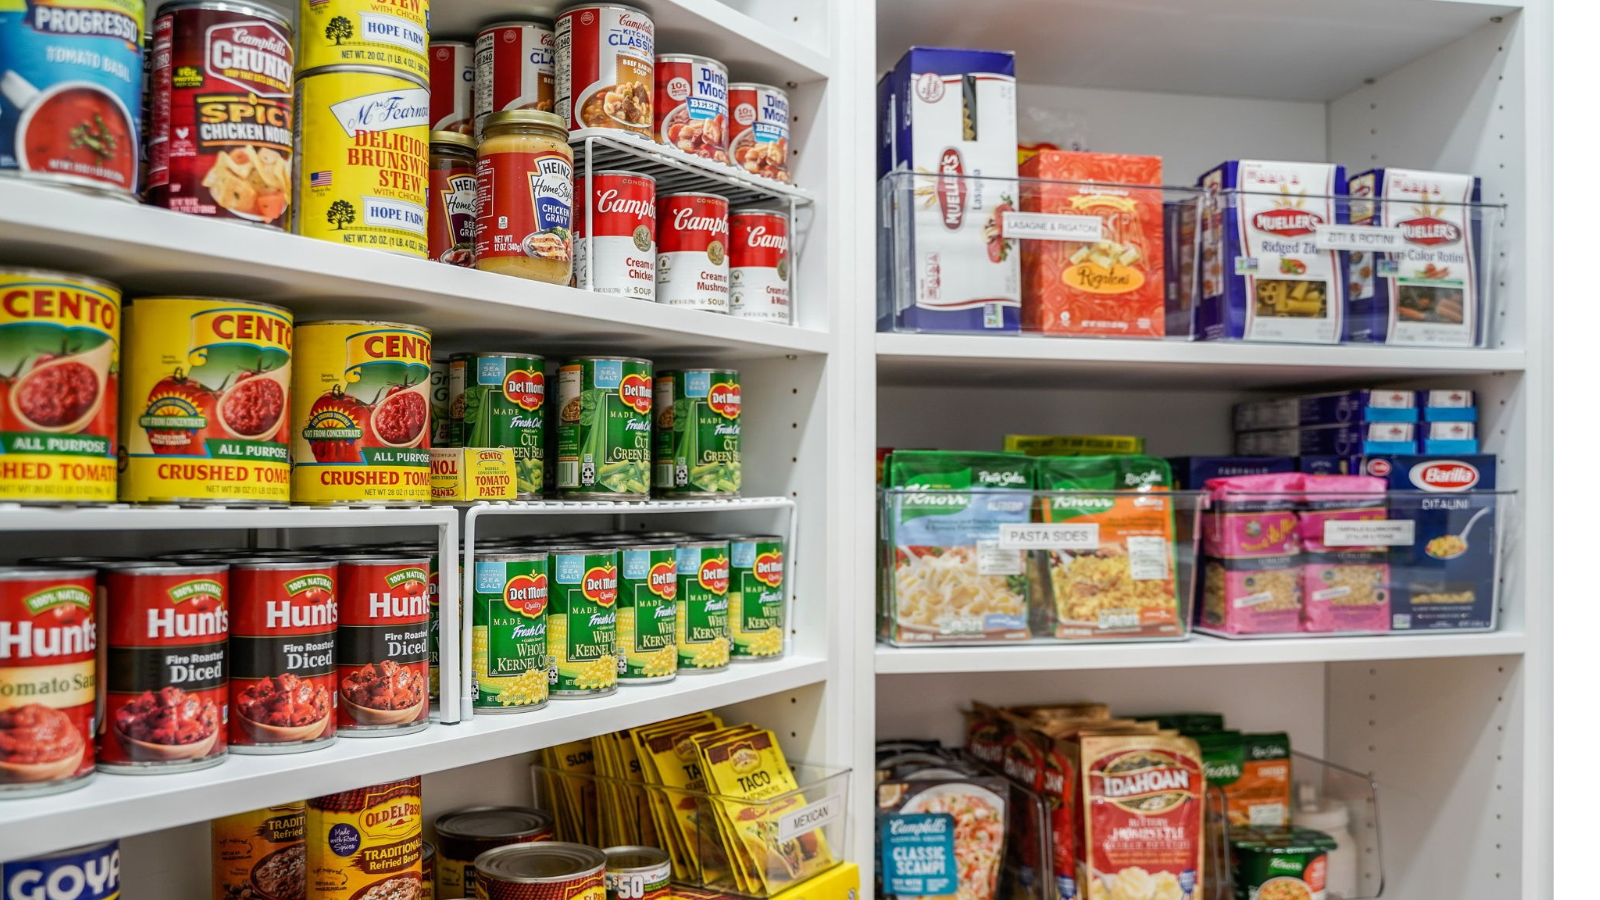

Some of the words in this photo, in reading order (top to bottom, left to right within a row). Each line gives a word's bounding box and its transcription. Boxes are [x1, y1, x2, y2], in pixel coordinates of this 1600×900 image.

[371, 4, 393, 14] WITH
[396, 8, 423, 24] CHICKEN
[35, 6, 137, 43] PROGRESSO
[368, 22, 400, 37] HOPE
[403, 29, 424, 46] FARM
[46, 46, 101, 69] TOMATO
[102, 56, 131, 83] BASIL
[212, 40, 293, 88] CHUNKY
[623, 59, 637, 67] BEEF
[633, 68, 647, 77] SOUP
[690, 99, 719, 109] BEEF
[201, 103, 292, 129] SPICY
[201, 122, 264, 140] CHICKEN
[543, 163, 571, 179] HEINZ
[379, 169, 422, 194] STEW
[373, 187, 395, 198] WITH
[398, 191, 424, 204] CHICKEN
[942, 154, 962, 224] MUELLER'S
[370, 206, 401, 220] HOPE
[405, 212, 424, 226] FARM
[542, 204, 570, 217] CHICKEN
[545, 214, 568, 226] GRAVY
[1008, 221, 1047, 230] LASAGNE
[1050, 222, 1056, 230] &
[1058, 222, 1098, 232] RIGATONI
[1257, 215, 1320, 231] MUELLER'S
[343, 234, 356, 243] NET
[357, 234, 369, 243] WT.
[369, 236, 378, 244] 20
[494, 235, 503, 243] NET
[504, 235, 513, 243] WT
[1327, 232, 1346, 243] ZITI
[1350, 233, 1356, 242] &
[1359, 233, 1394, 245] ROTINI
[1261, 241, 1299, 257] Ridged
[626, 257, 650, 268] Cream
[1437, 252, 1464, 264] Rotini
[629, 269, 653, 281] Chicken
[700, 271, 724, 281] Cream
[1078, 267, 1129, 289] Rigatoni
[634, 286, 651, 296] SOUP
[707, 298, 725, 306] SOUP
[3, 290, 115, 330] CENTO
[212, 314, 292, 350] CENTO
[508, 381, 524, 393] Del
[624, 385, 638, 396] Del
[610, 411, 634, 419] MADE
[166, 417, 206, 428] CONCENTRATE
[304, 429, 314, 437] NOT
[314, 429, 326, 437] FROM
[326, 429, 360, 438] CONCENTRATE
[521, 433, 537, 446] CUT
[13, 437, 45, 451] ALL
[47, 438, 106, 453] PURPOSE
[634, 436, 648, 449] CUT
[723, 440, 738, 451] CUT
[218, 444, 243, 455] ALL
[245, 445, 287, 458] PURPOSE
[480, 452, 502, 460] CENTO
[613, 447, 642, 460] GREEN
[703, 450, 732, 462] GREEN
[373, 453, 394, 462] ALL
[396, 453, 430, 463] PURPOSE
[158, 464, 249, 481] CRUSHED
[320, 471, 399, 485] CRUSHED
[1424, 467, 1474, 483] Barilla
[475, 475, 510, 485] TOMATO
[206, 485, 220, 493] NET
[480, 486, 505, 496] PASTE
[905, 483, 968, 506] Knorr
[1053, 489, 1114, 509] Knorr
[1422, 499, 1468, 510] DITALINI
[1010, 531, 1049, 541] PASTA
[1053, 530, 1088, 542] SIDES
[388, 573, 406, 584] 100%
[406, 570, 428, 583] NATURAL
[173, 585, 193, 598] 100%
[194, 582, 222, 597] NATURAL
[289, 579, 307, 592] 100%
[307, 577, 332, 590] NATURAL
[587, 579, 602, 591] Del
[30, 592, 56, 608] 100%
[57, 590, 92, 606] NATURAL
[509, 588, 527, 601] Del
[690, 594, 712, 602] MADE
[524, 601, 541, 610] Quality
[493, 617, 521, 625] MADE
[385, 632, 403, 641] Fire
[404, 628, 428, 640] Roasted
[692, 627, 721, 640] KERNEL
[283, 644, 304, 654] Fire
[306, 640, 334, 651] Roasted
[387, 639, 427, 657] Diced
[642, 635, 672, 648] KERNEL
[516, 642, 546, 657] WHOLE
[575, 644, 610, 657] KERNEL
[166, 655, 190, 665] Fire
[191, 650, 223, 664] Roasted
[286, 650, 333, 670] Diced
[497, 656, 537, 671] KERNEL
[170, 661, 222, 683] Diced
[737, 770, 770, 793] TACO
[1103, 769, 1189, 796] IDAHOAN
[366, 807, 391, 828] OLD
[390, 805, 404, 820] EL
[793, 806, 830, 830] MEXICAN
[334, 827, 350, 836] Made
[889, 818, 947, 836] Campbell's
[273, 828, 303, 840] Refried
[334, 843, 355, 852] Spices
[364, 840, 421, 861] TRADITIONAL
[893, 846, 946, 860] CLASSIC
[370, 858, 402, 871] Refried
[403, 852, 419, 865] Beans
[896, 860, 946, 875] SCAMPI
[1270, 858, 1303, 871] Knorr
